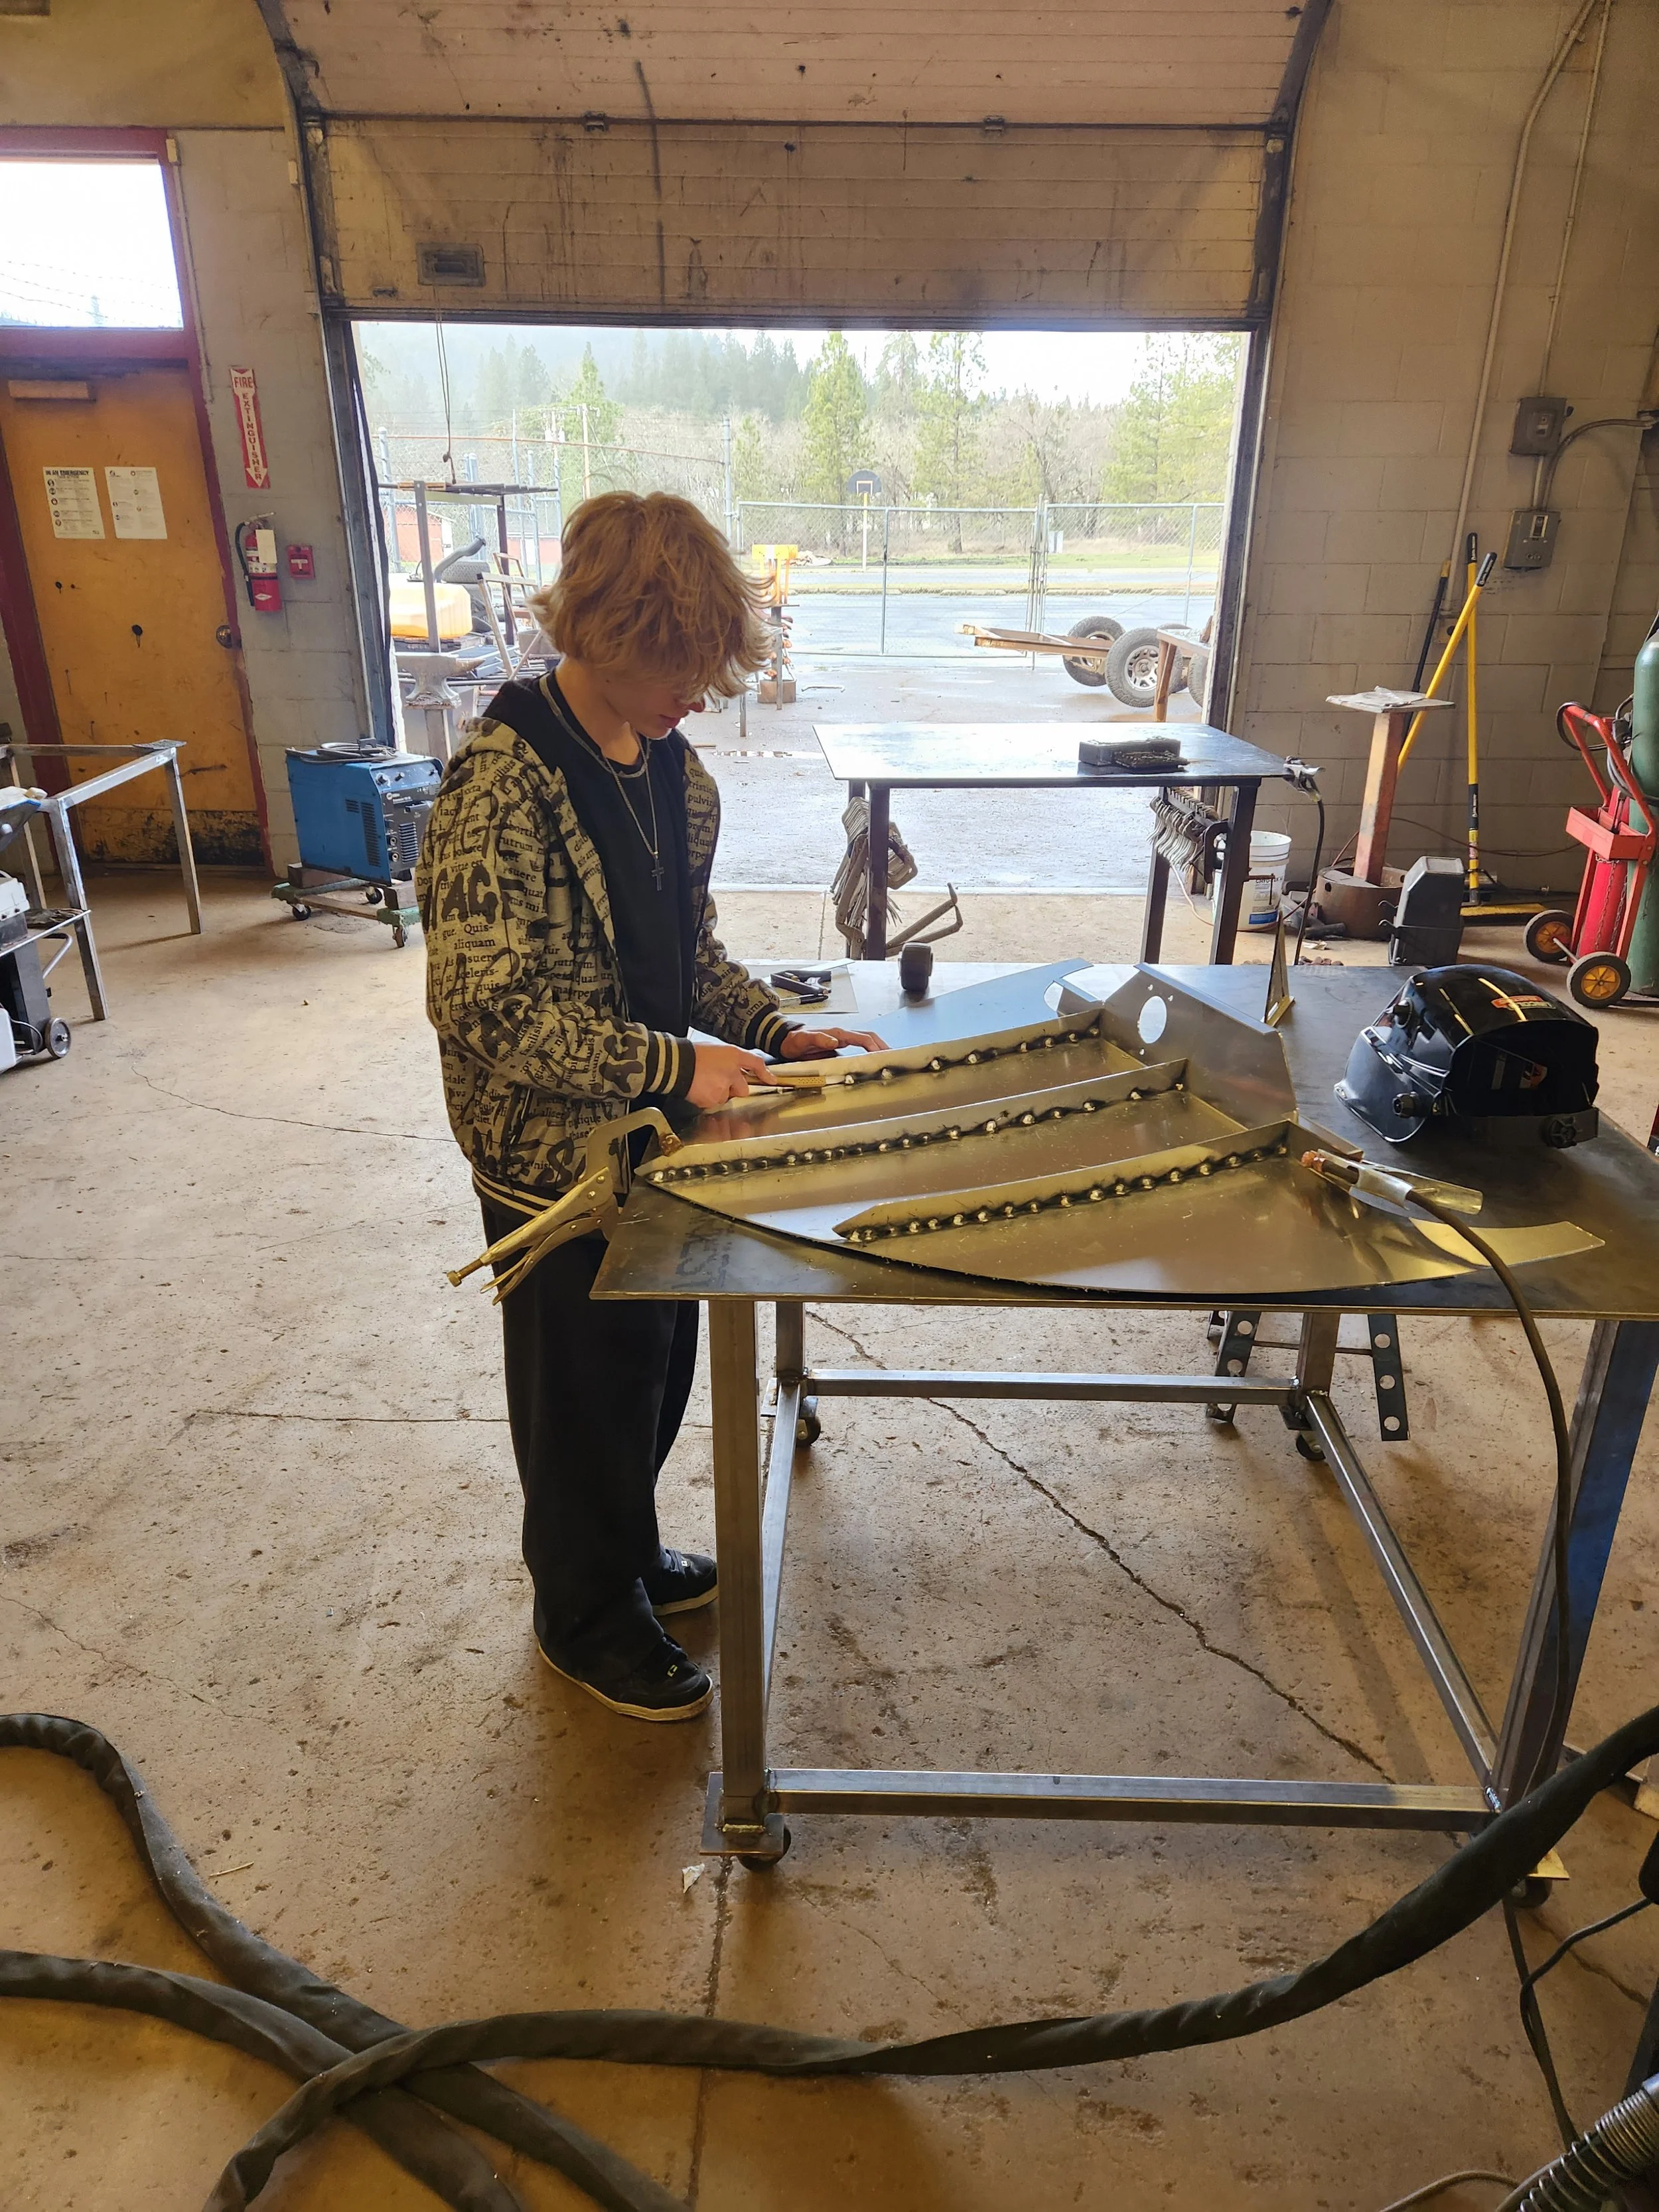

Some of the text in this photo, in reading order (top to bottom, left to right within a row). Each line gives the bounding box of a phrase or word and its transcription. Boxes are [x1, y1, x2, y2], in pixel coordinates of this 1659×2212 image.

[234, 376, 253, 388] FIRE
[242, 392, 262, 480] EXTINGUISHER
[464, 923, 494, 935] Quis-
[454, 938, 496, 951] aliquam
[746, 999, 764, 1017] urna
